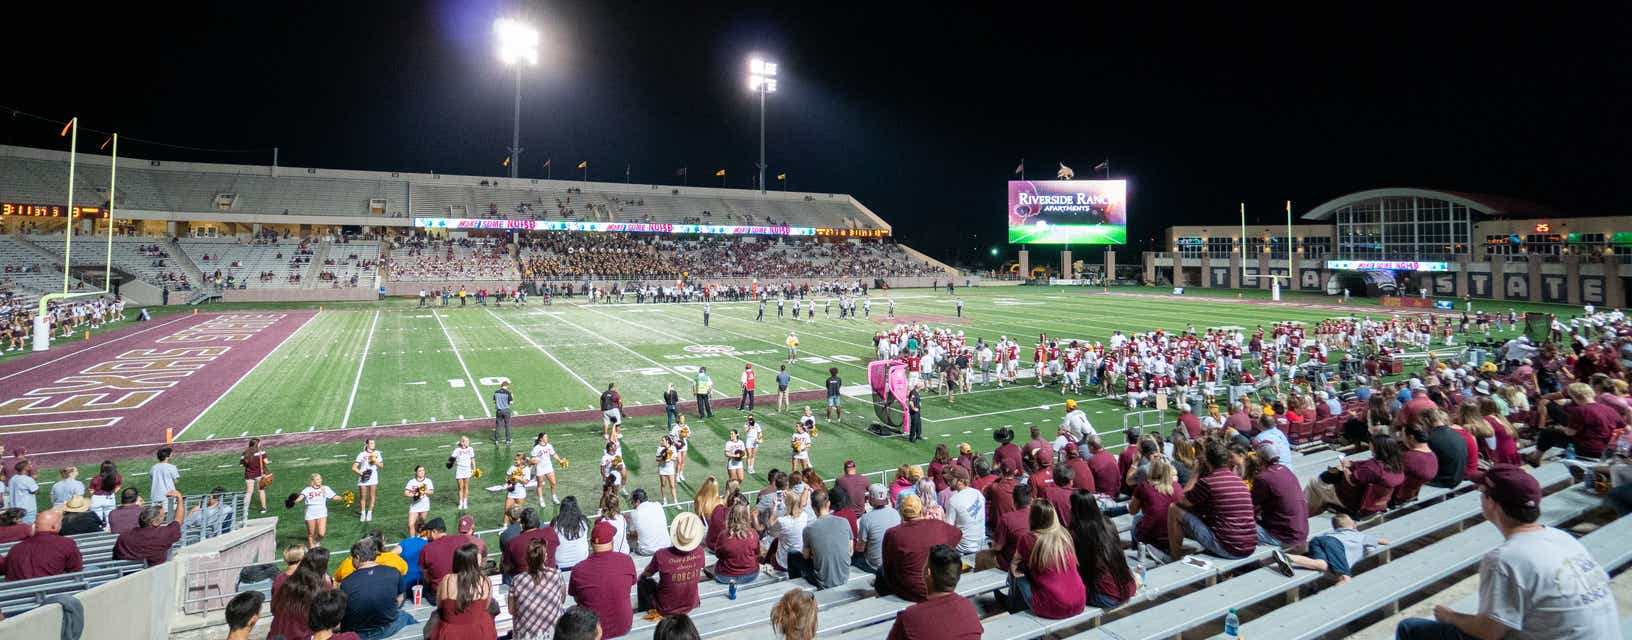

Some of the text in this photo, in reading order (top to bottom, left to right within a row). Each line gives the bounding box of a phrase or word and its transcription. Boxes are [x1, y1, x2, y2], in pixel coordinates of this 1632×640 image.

[1018, 192, 1073, 205] RIVERSIDE
[1536, 223, 1550, 233] 25
[1213, 267, 1603, 303] TEXAS STATE
